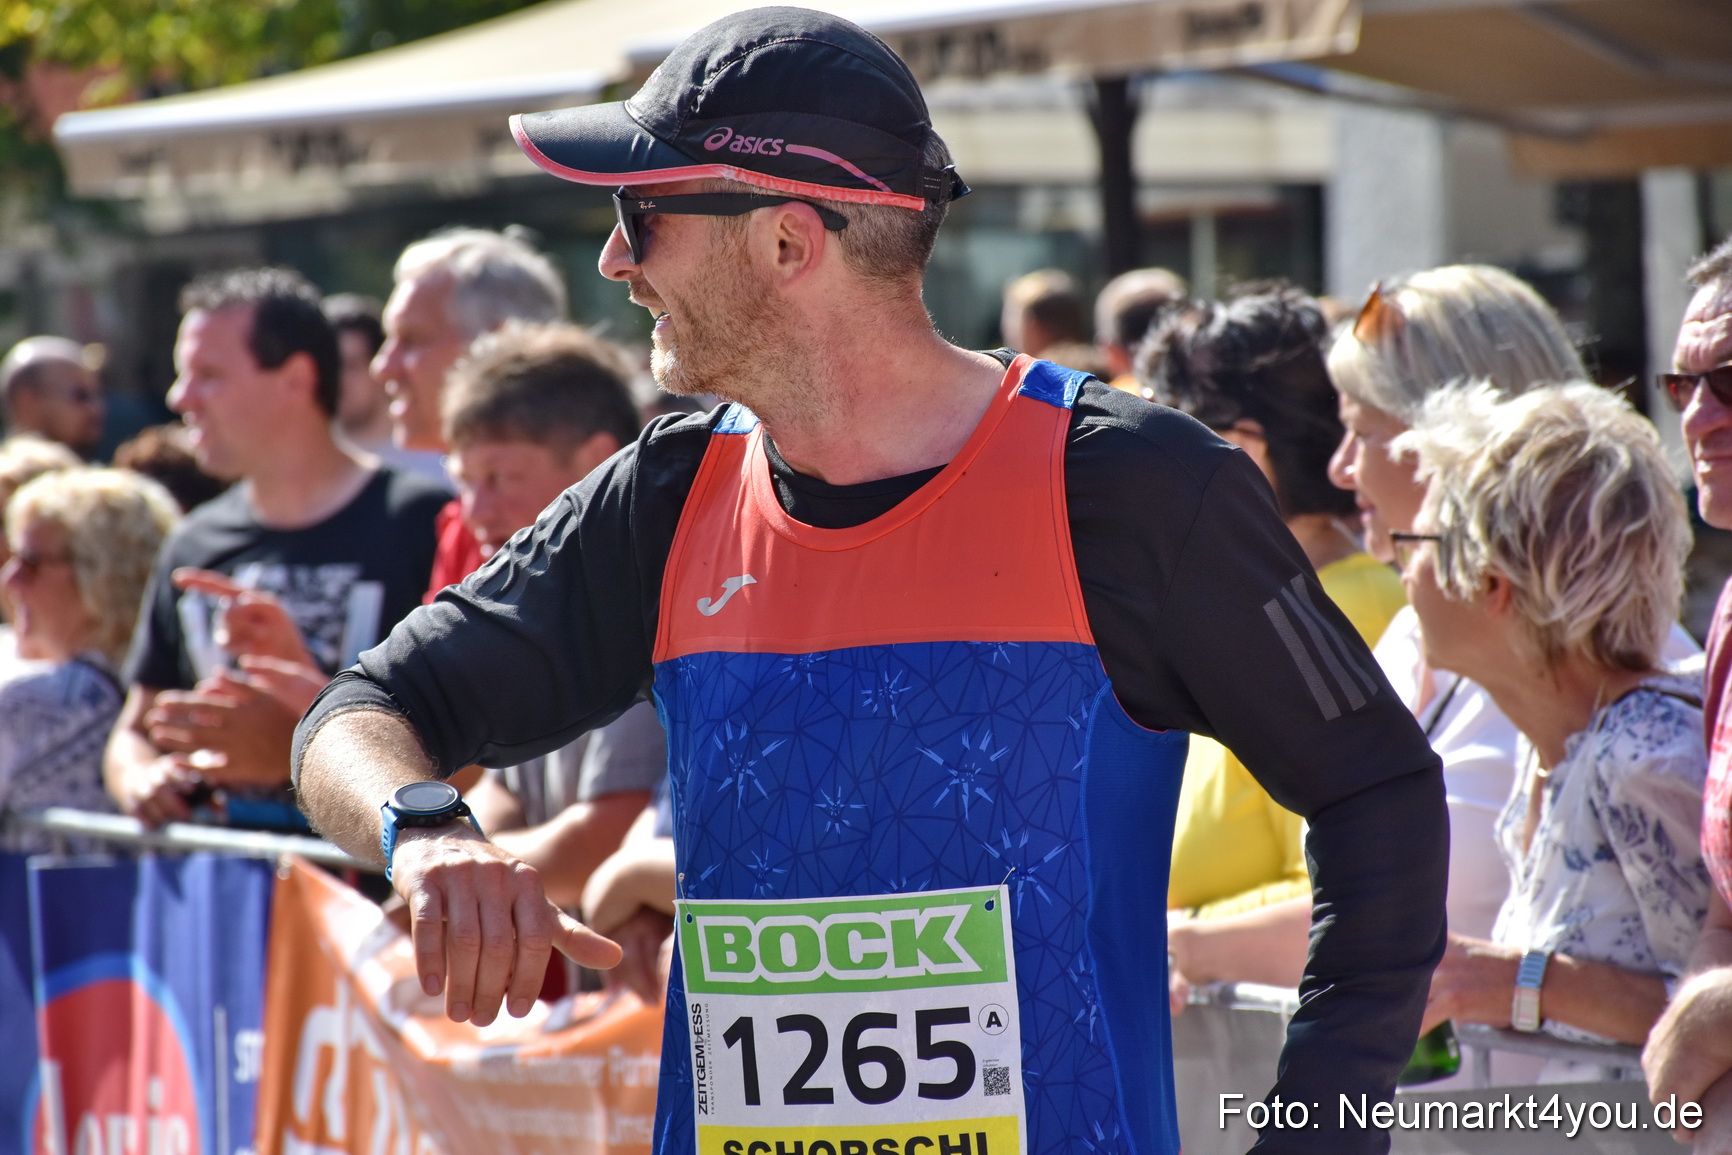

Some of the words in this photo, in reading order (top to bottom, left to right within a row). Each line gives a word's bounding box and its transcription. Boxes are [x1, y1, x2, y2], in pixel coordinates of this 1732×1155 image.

[728, 133, 785, 156] asics
[697, 905, 981, 982] BOCK
[986, 1011, 1003, 1028] A
[722, 1006, 976, 1106] 1265
